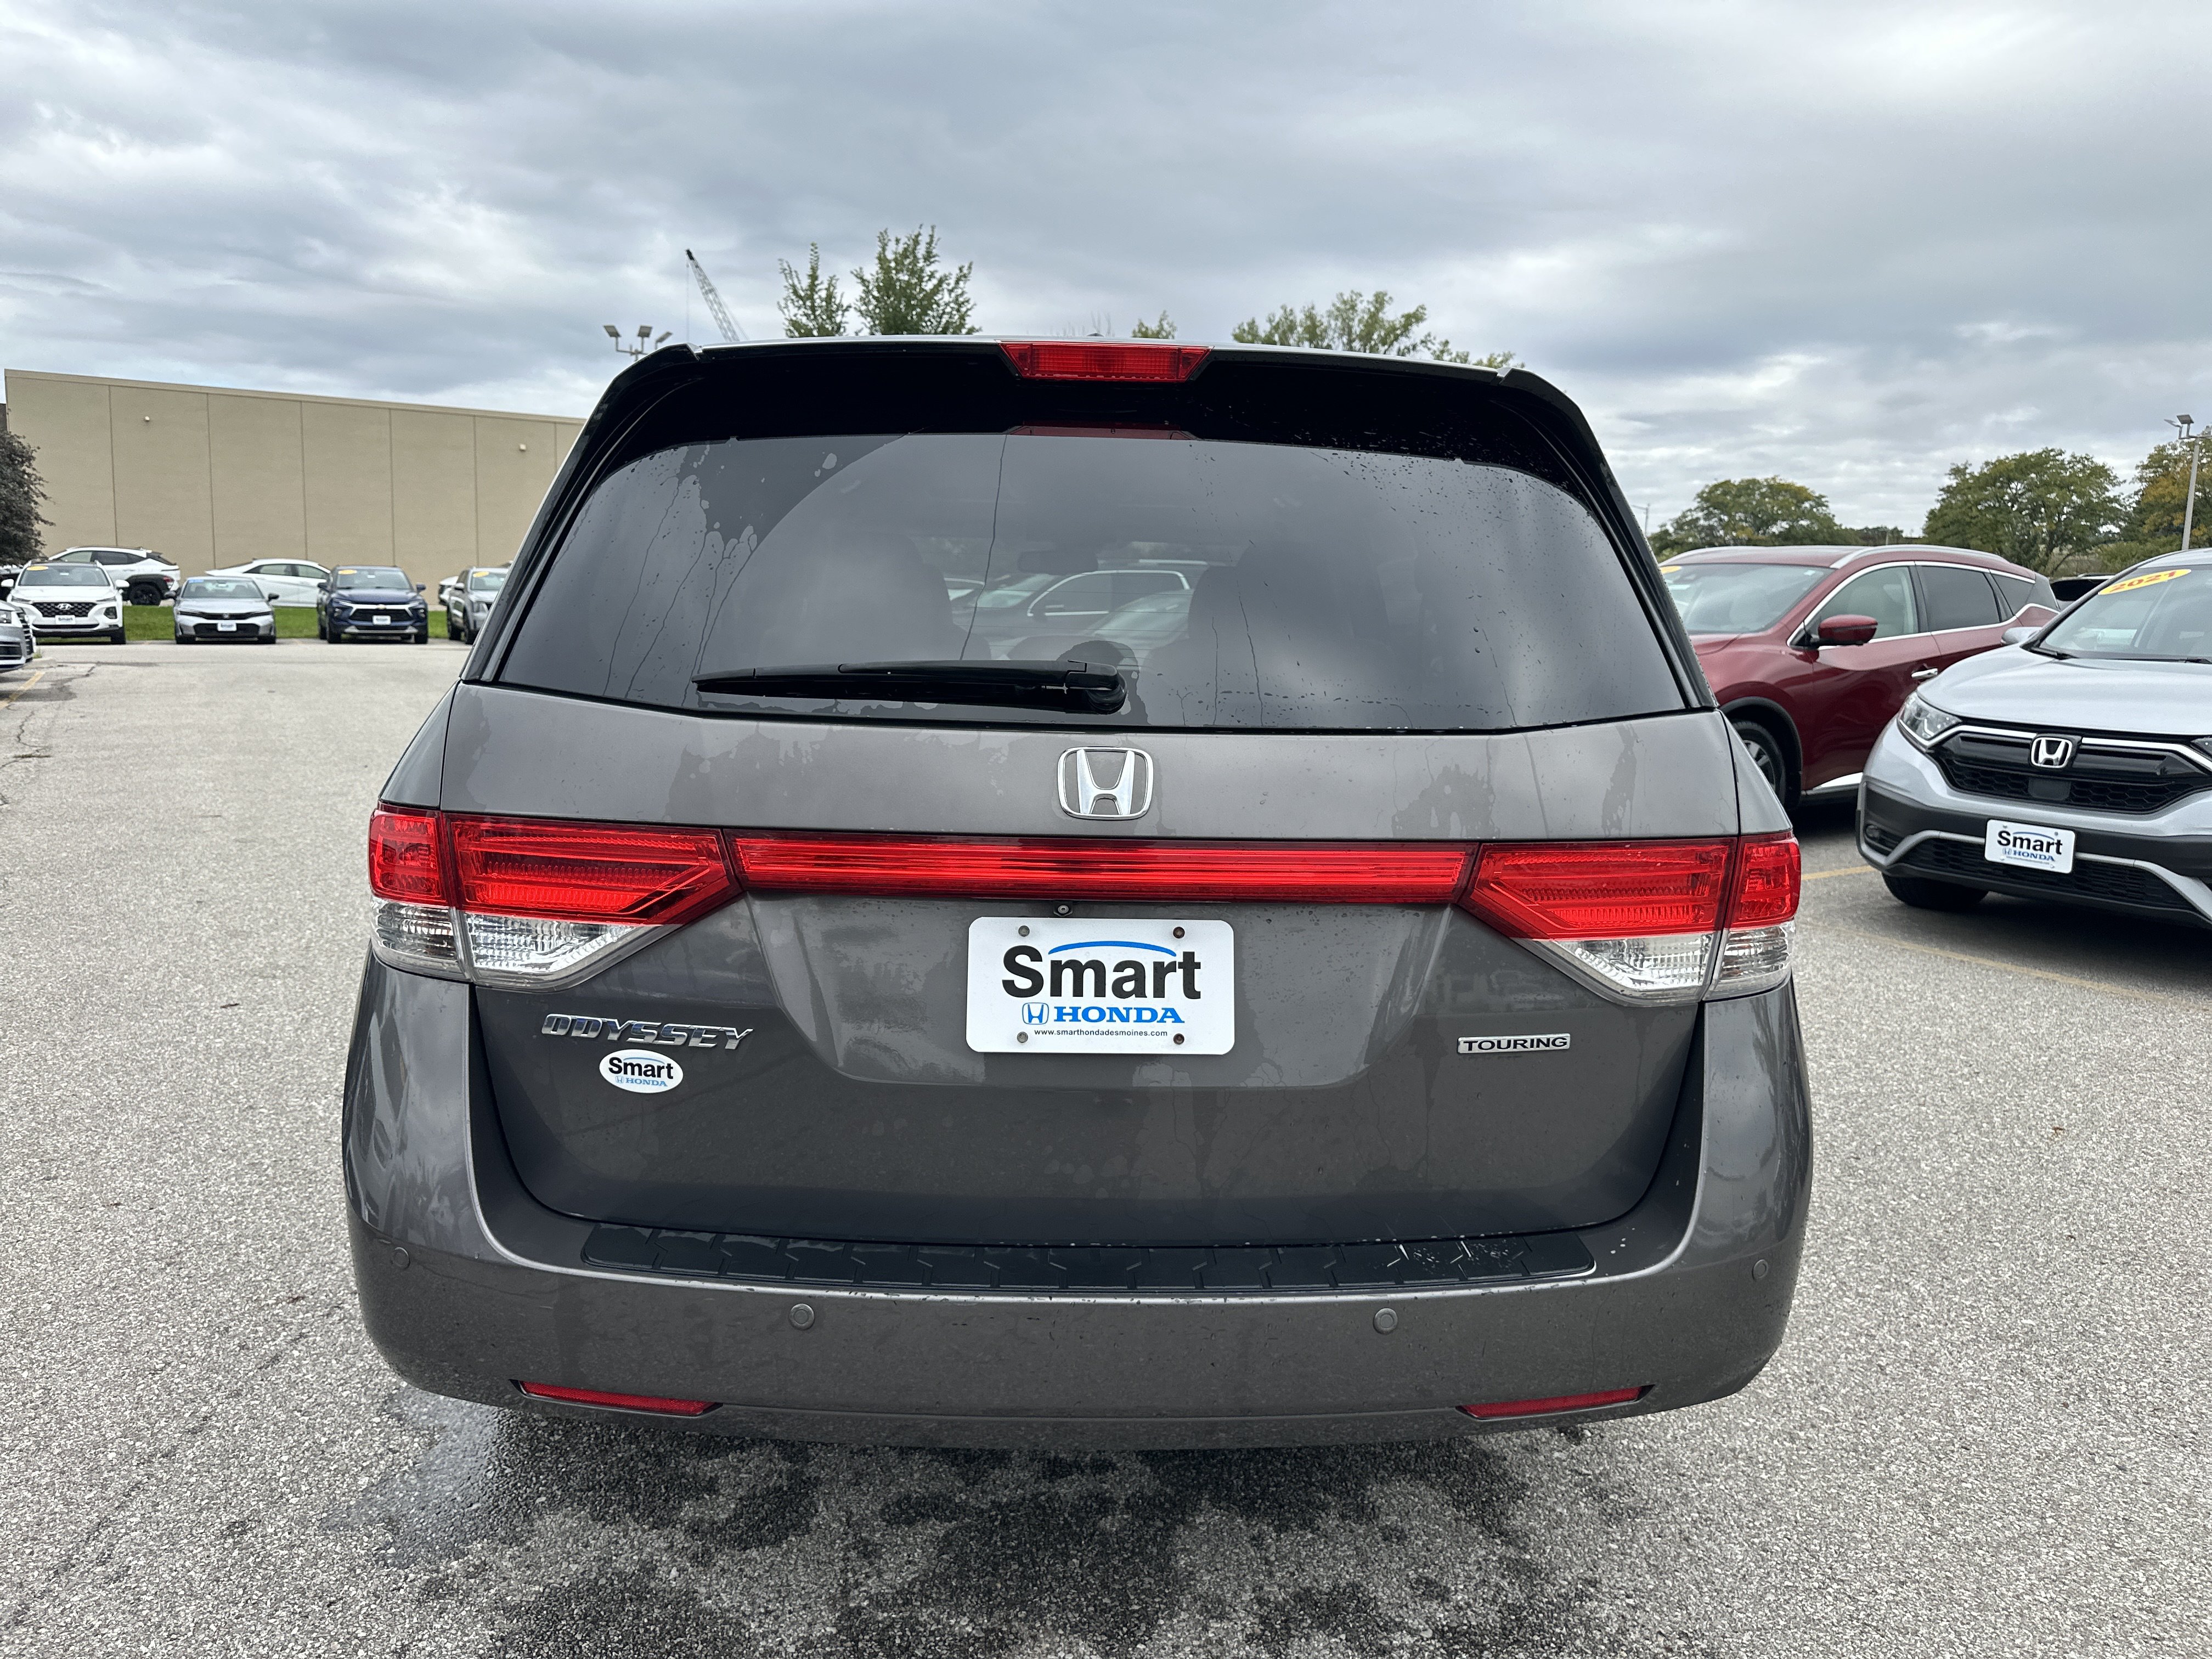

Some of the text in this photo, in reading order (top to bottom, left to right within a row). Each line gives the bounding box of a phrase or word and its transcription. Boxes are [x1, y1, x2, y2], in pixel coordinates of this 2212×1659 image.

[2109, 571, 2176, 592] 2021
[1997, 830, 2063, 855] Smart
[2013, 849, 2056, 861] HONDA
[1002, 945, 1201, 1000] Smart
[1053, 1006, 1185, 1024] HONDA
[541, 1013, 753, 1050] ODYSSEY
[1034, 1028, 1168, 1037] www.smarthondadesmoines.com
[1463, 1037, 1567, 1051] TOURING
[608, 1057, 674, 1079] Smart
[625, 1077, 668, 1087] HONDA
